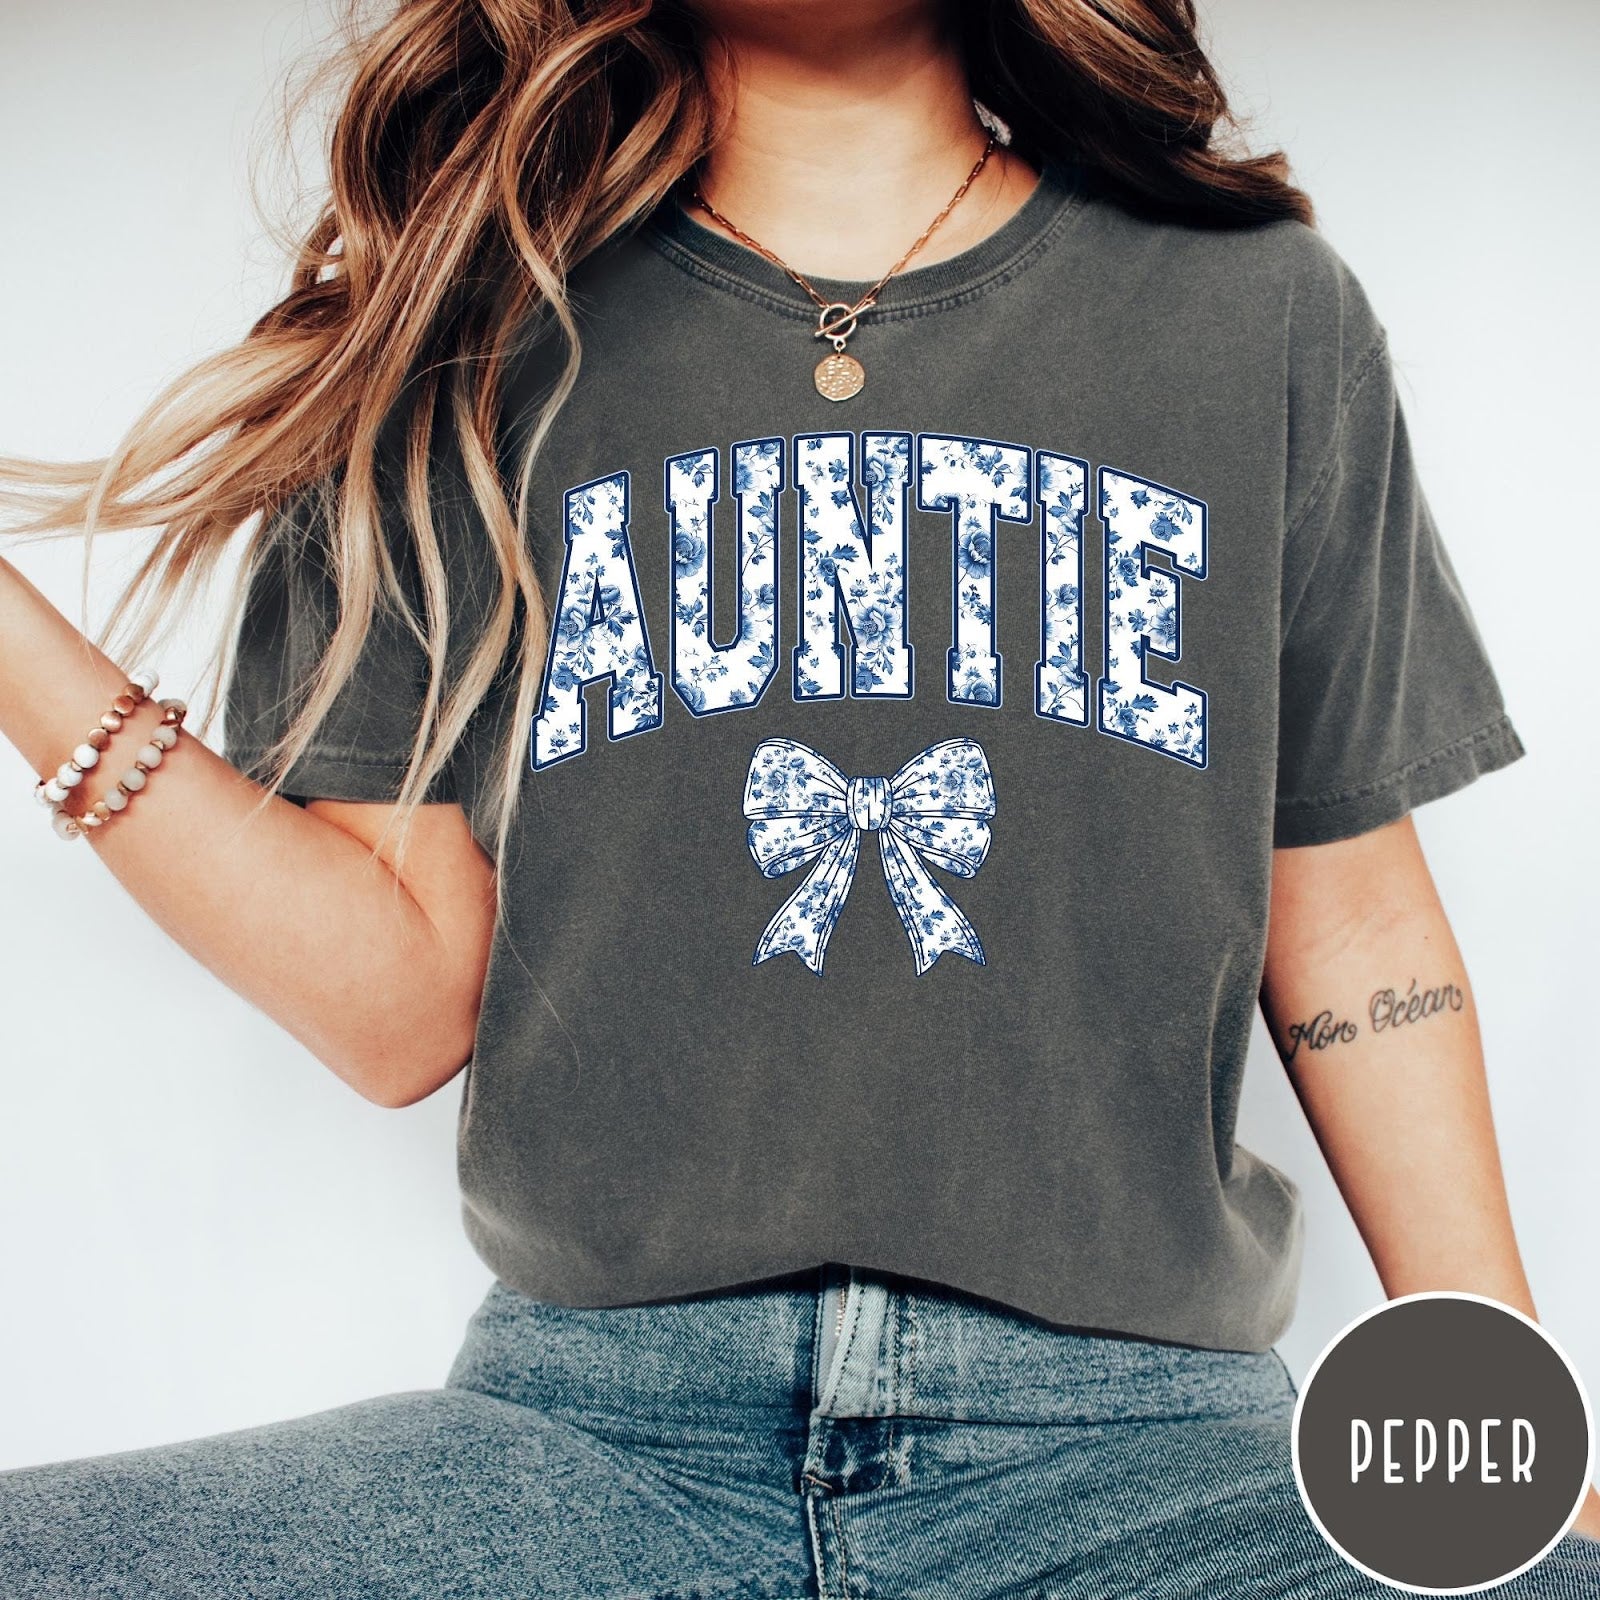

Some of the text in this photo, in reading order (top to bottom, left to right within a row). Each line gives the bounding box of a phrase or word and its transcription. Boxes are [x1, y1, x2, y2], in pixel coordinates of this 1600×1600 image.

[531, 431, 1208, 771] AUNTIE
[1286, 978, 1463, 1061] Mon Océan
